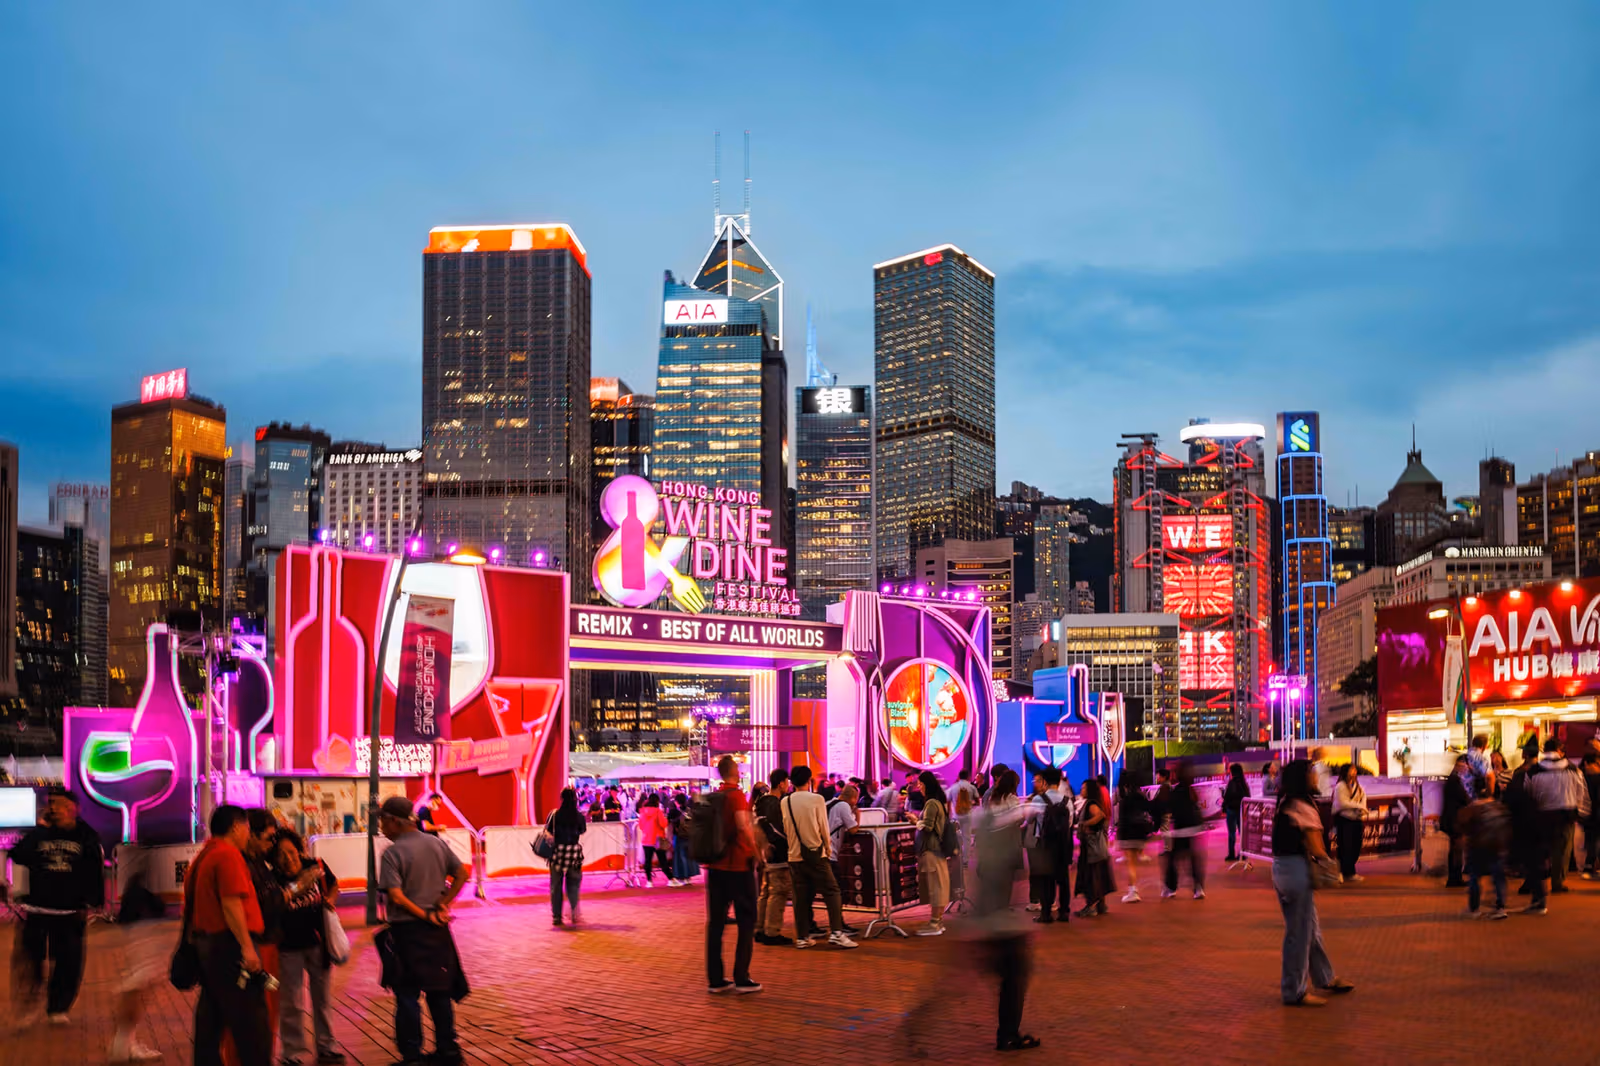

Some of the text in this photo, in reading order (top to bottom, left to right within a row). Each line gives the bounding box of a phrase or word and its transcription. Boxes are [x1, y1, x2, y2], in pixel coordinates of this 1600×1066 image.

[675, 304, 717, 320] AIA
[814, 387, 853, 414] 銀
[329, 452, 404, 464] BANK OF AMERICA
[662, 480, 759, 504] HONG KONG
[662, 498, 772, 545] WINE
[1167, 526, 1222, 548] WE
[693, 540, 788, 586] DINE
[1461, 546, 1544, 558] MANDARIN ORIENTAL
[714, 582, 800, 602] FESTIVAL
[578, 613, 824, 647] REMIX BEST OF ALL WORLDS
[1468, 593, 1600, 657] AIA Vi
[1493, 654, 1549, 682] HUB
[423, 635, 436, 735] HONG KONG
